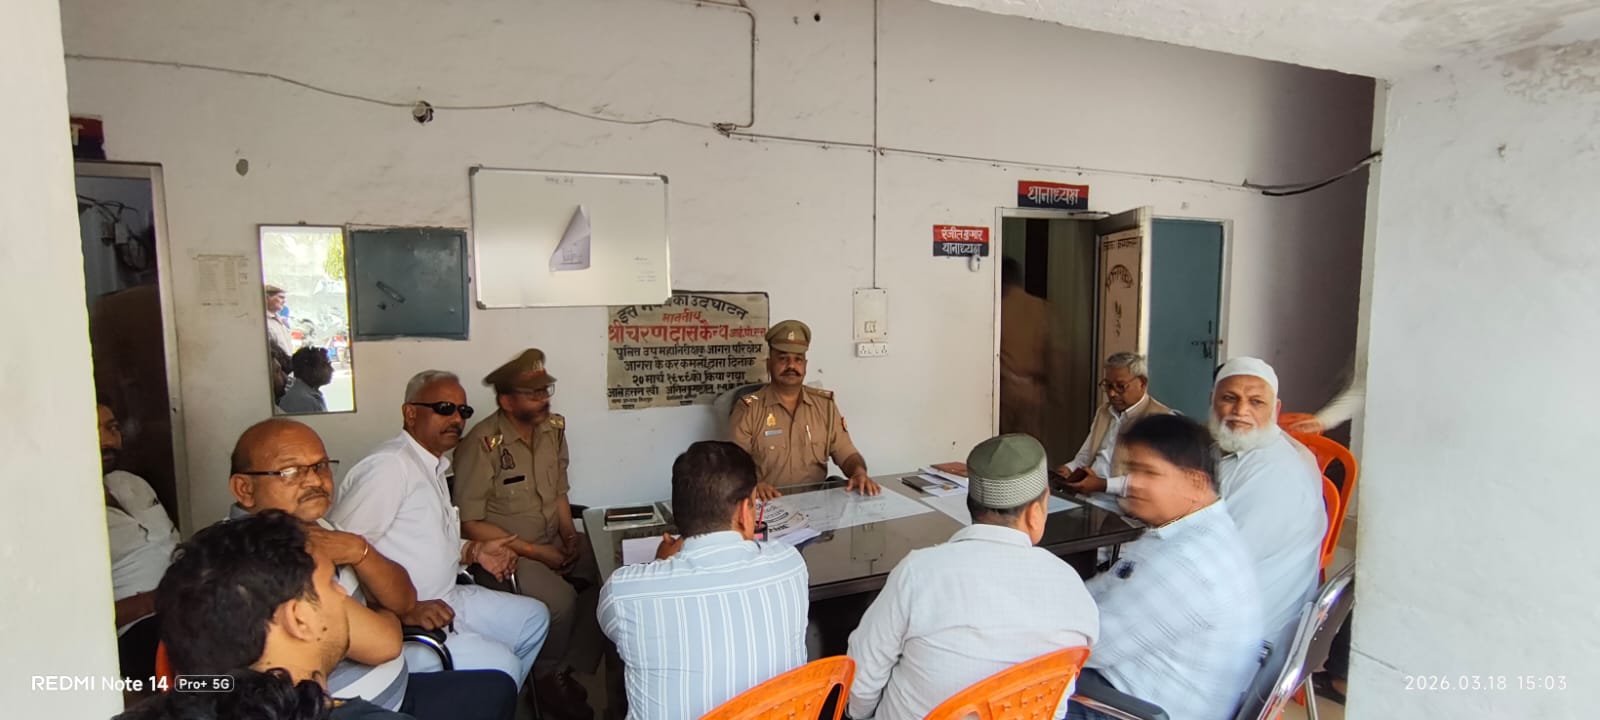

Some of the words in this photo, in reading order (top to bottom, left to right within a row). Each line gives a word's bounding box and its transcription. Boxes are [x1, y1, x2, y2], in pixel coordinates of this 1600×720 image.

[1027, 185, 1080, 205] थानाध्यक्ष
[941, 226, 963, 240] रंजीत
[963, 229, 983, 241] कुमार
[673, 295, 689, 307] का
[608, 319, 624, 343] श्री
[625, 325, 667, 343] चरण
[669, 325, 699, 344] दास
[613, 345, 641, 360] पुलिस
[707, 344, 731, 354] आगरा
[624, 360, 653, 371] आगरा
[727, 371, 746, 381] गया
